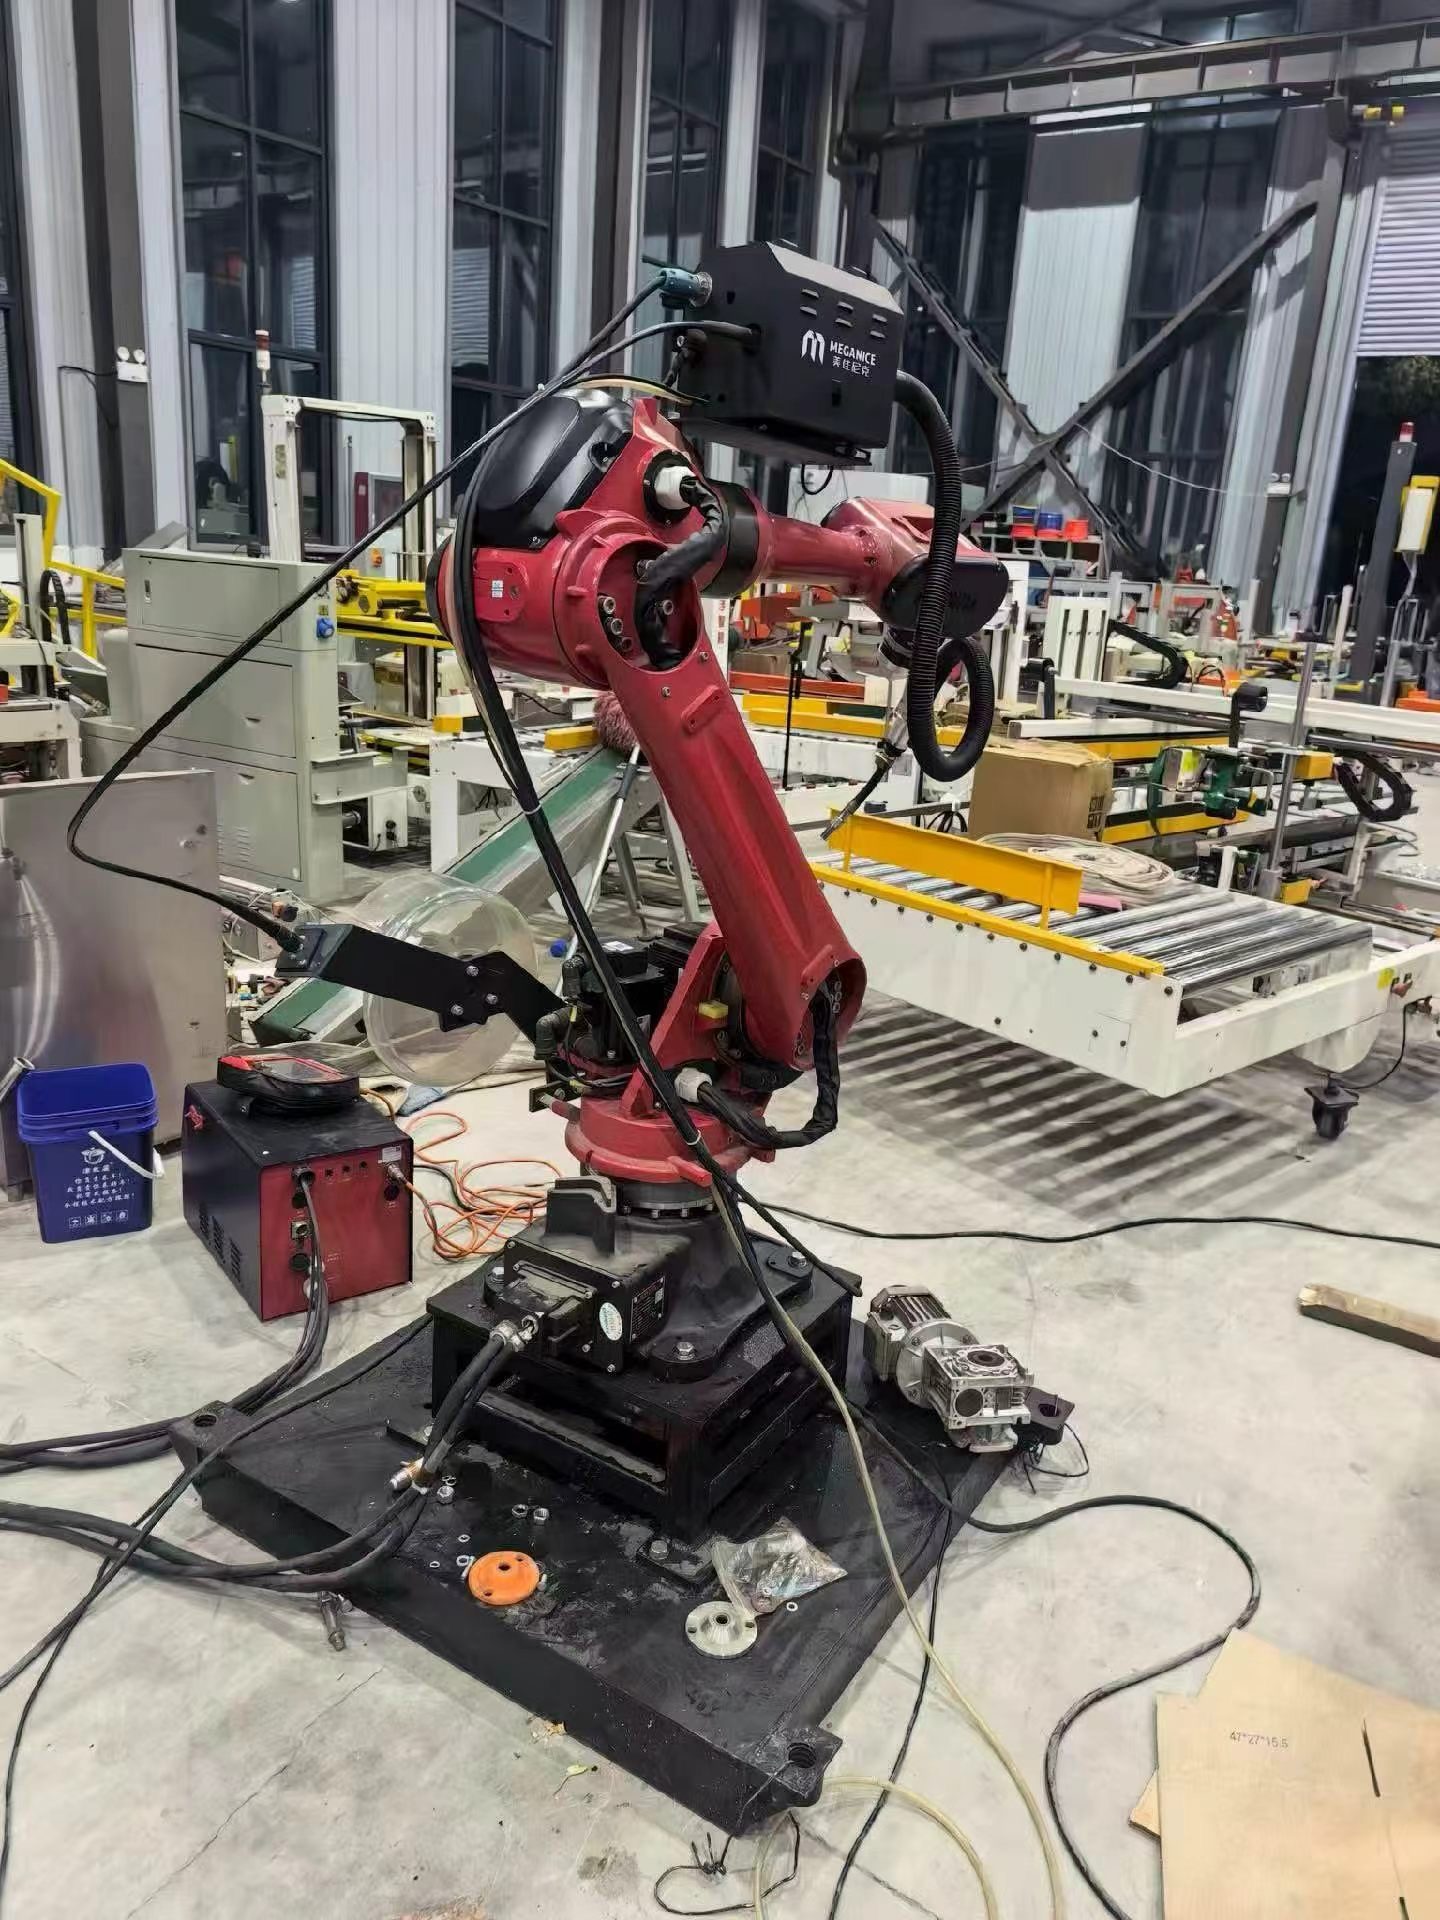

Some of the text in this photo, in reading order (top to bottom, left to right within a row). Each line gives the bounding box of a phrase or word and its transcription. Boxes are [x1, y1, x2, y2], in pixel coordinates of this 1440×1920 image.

[830, 340, 877, 366] MEGANICE
[832, 355, 870, 377] 美佳尼克
